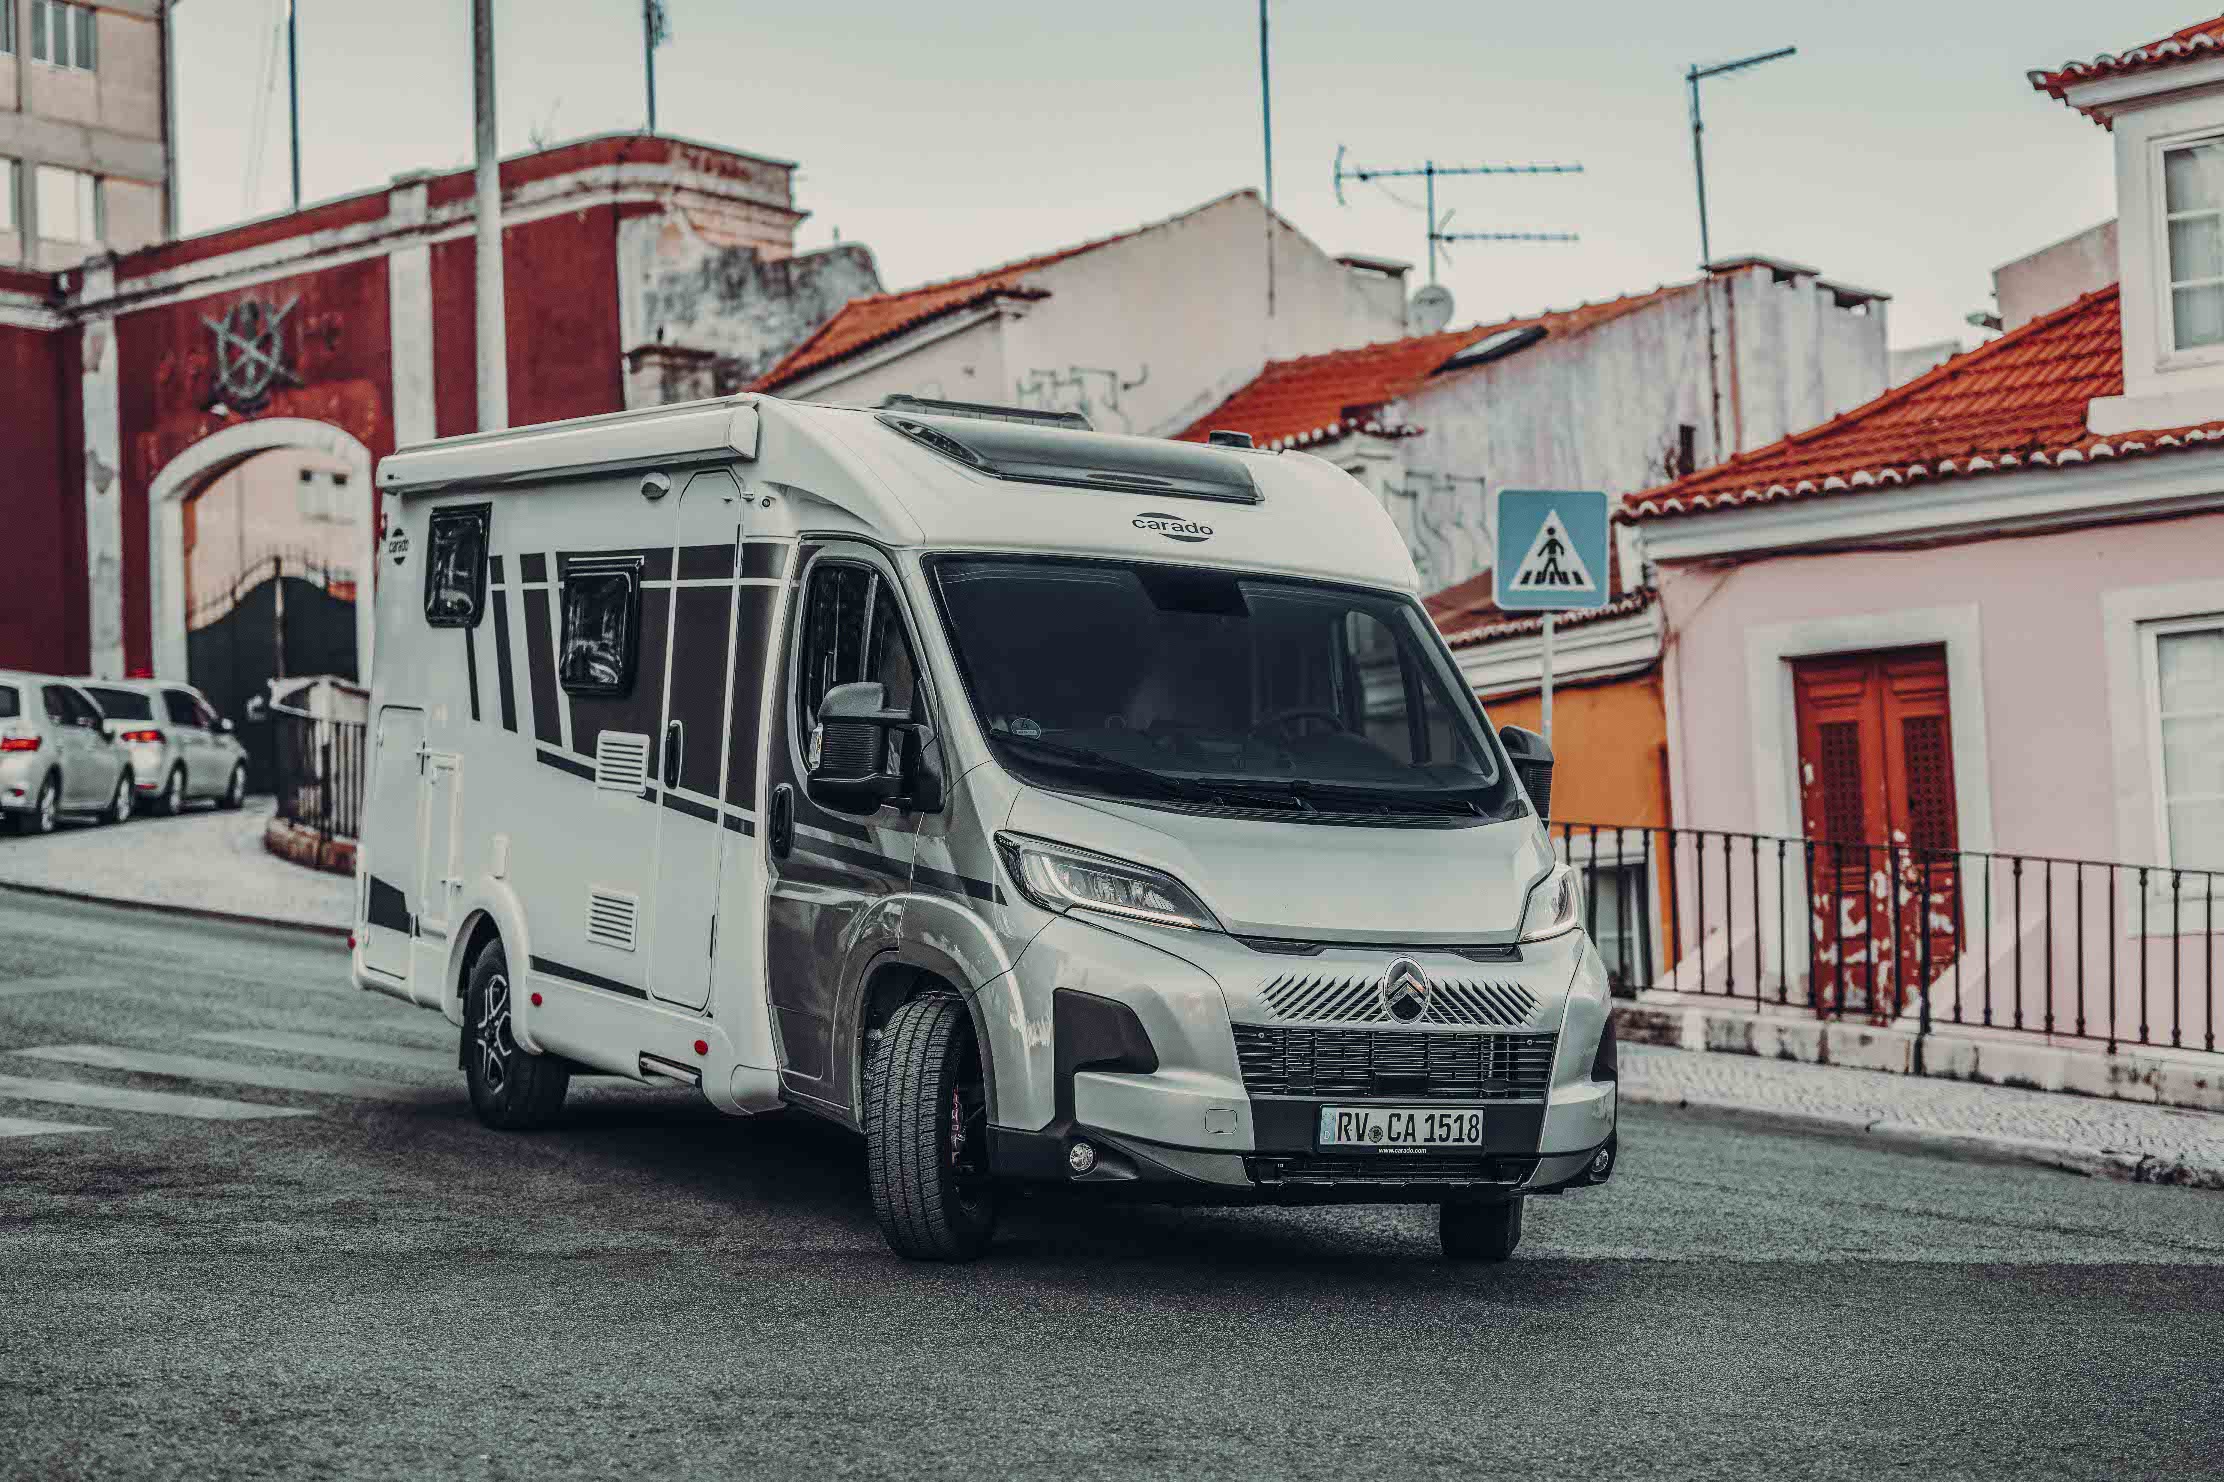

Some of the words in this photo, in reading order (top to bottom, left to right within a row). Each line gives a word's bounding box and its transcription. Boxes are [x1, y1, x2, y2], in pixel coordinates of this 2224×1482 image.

[1132, 519, 1214, 535] carado
[1337, 1112, 1369, 1142] RV
[1387, 1113, 1416, 1143] CA
[1423, 1113, 1480, 1143] 1518
